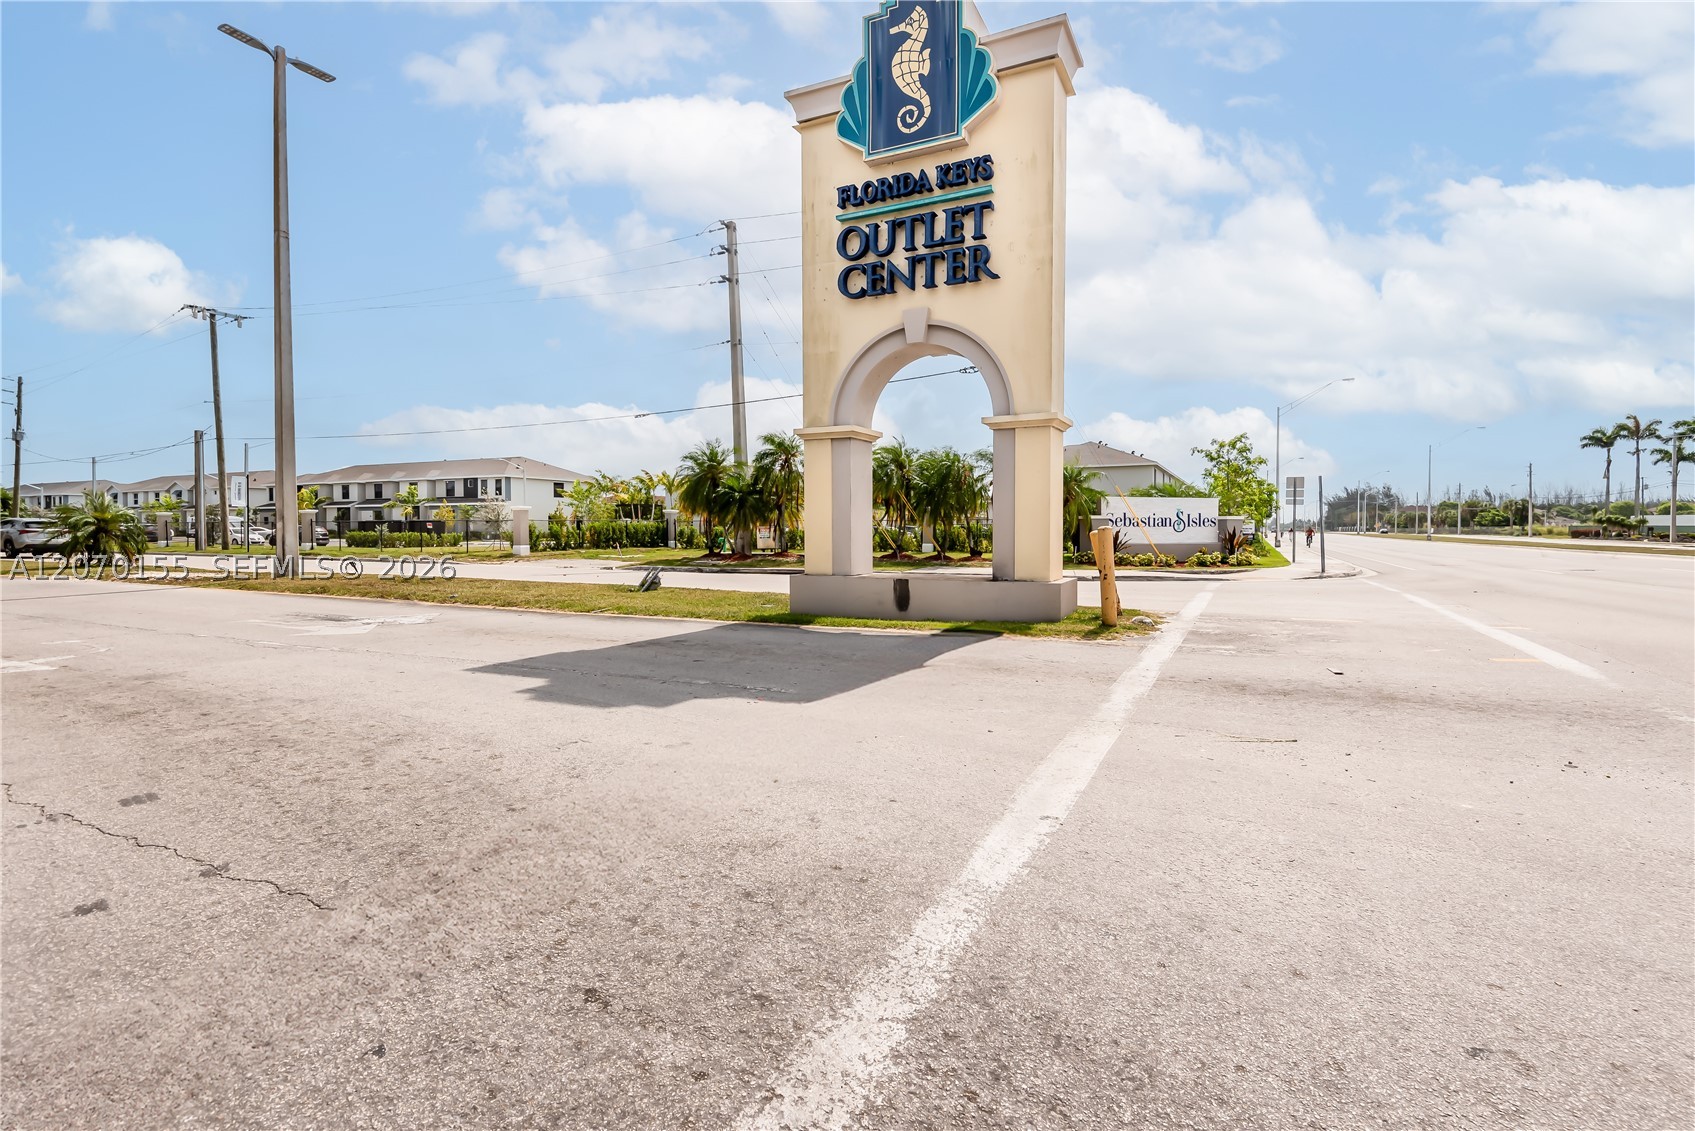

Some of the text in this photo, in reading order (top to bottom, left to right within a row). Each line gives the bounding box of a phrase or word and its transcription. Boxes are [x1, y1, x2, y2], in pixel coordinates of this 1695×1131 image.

[837, 154, 994, 209] FLORIDA KEYS
[837, 200, 994, 261] OUTLET
[837, 244, 1001, 299] CENTER
[1187, 512, 1217, 528] Isles
